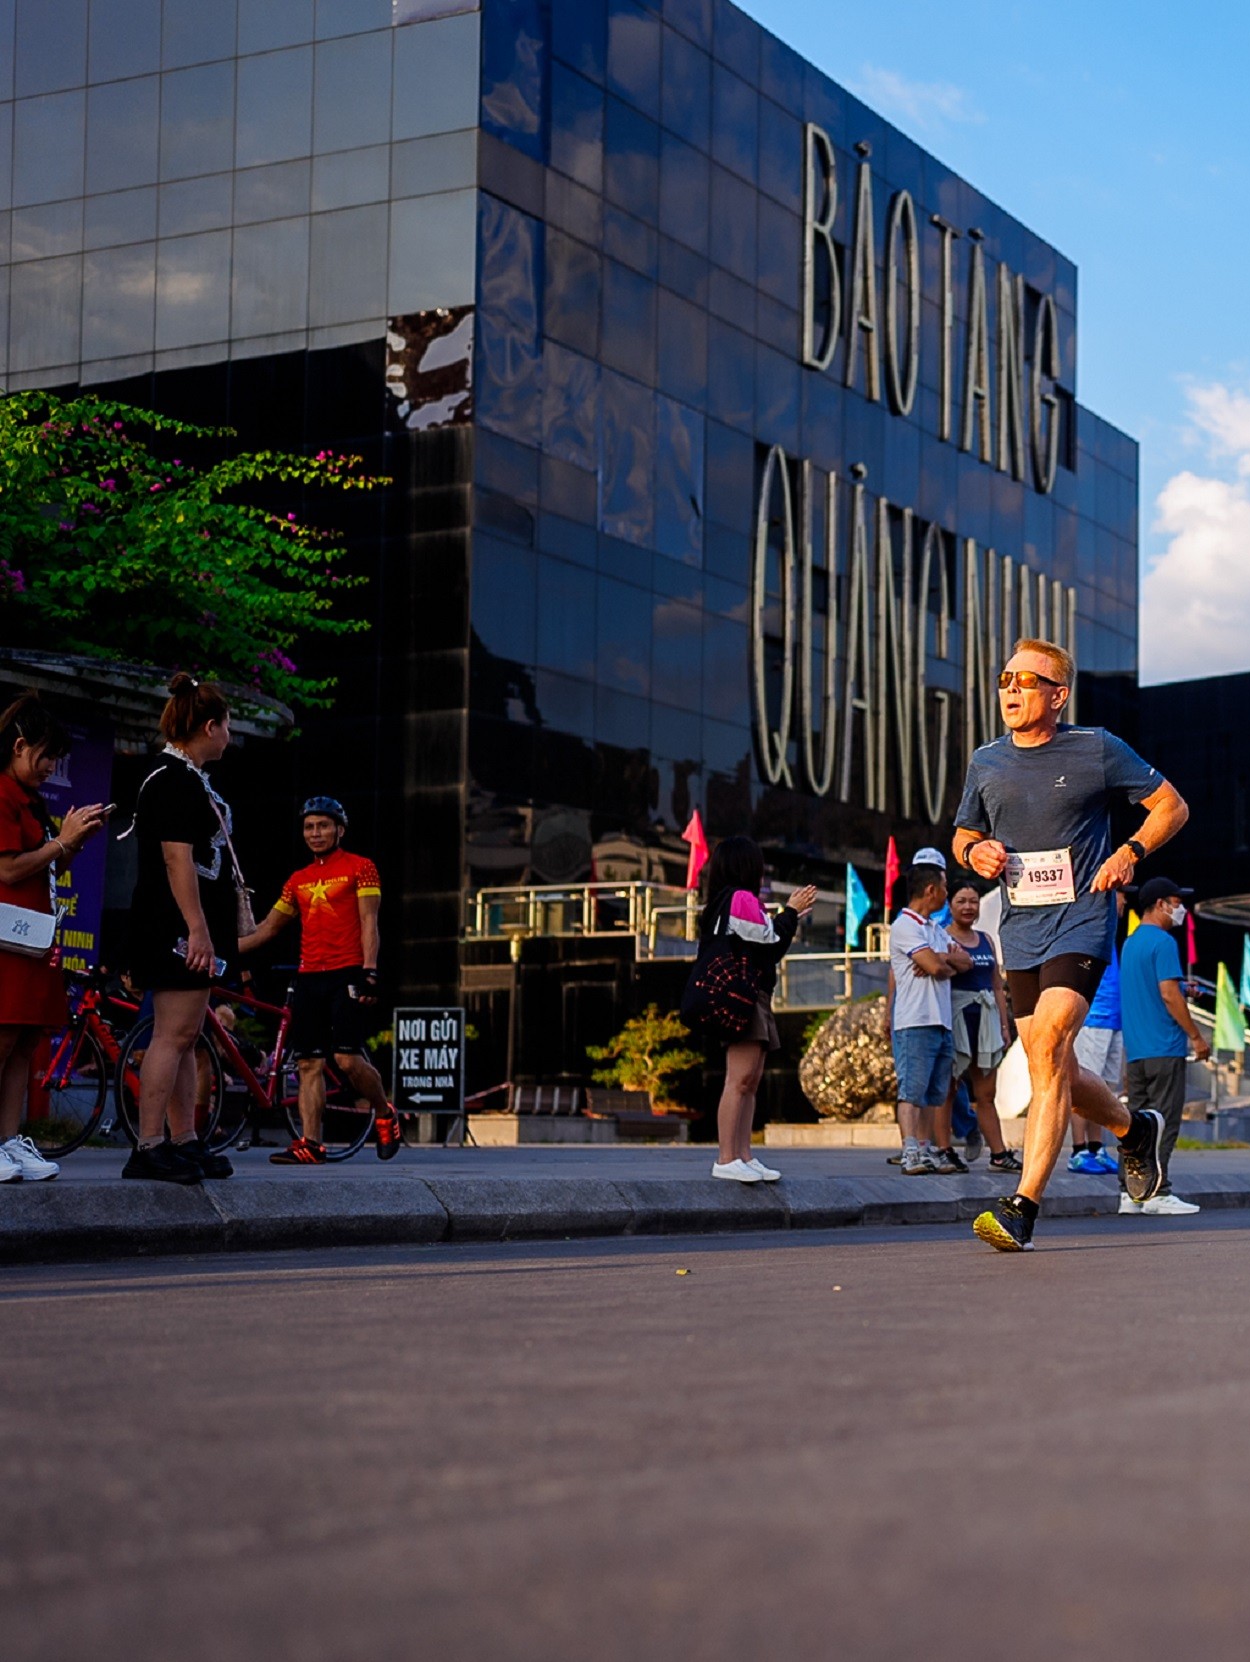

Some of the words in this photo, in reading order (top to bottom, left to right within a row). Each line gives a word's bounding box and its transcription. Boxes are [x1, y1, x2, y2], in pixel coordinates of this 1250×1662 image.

[1028, 868, 1064, 883] 19337
[62, 928, 95, 951] NINH
[399, 1018, 426, 1041] NƠI
[430, 1011, 457, 1041] GỬI
[399, 1048, 420, 1070] XE
[424, 1044, 458, 1070] MÁY
[402, 1076, 433, 1088] TRONG
[435, 1074, 455, 1088] NHÀ
